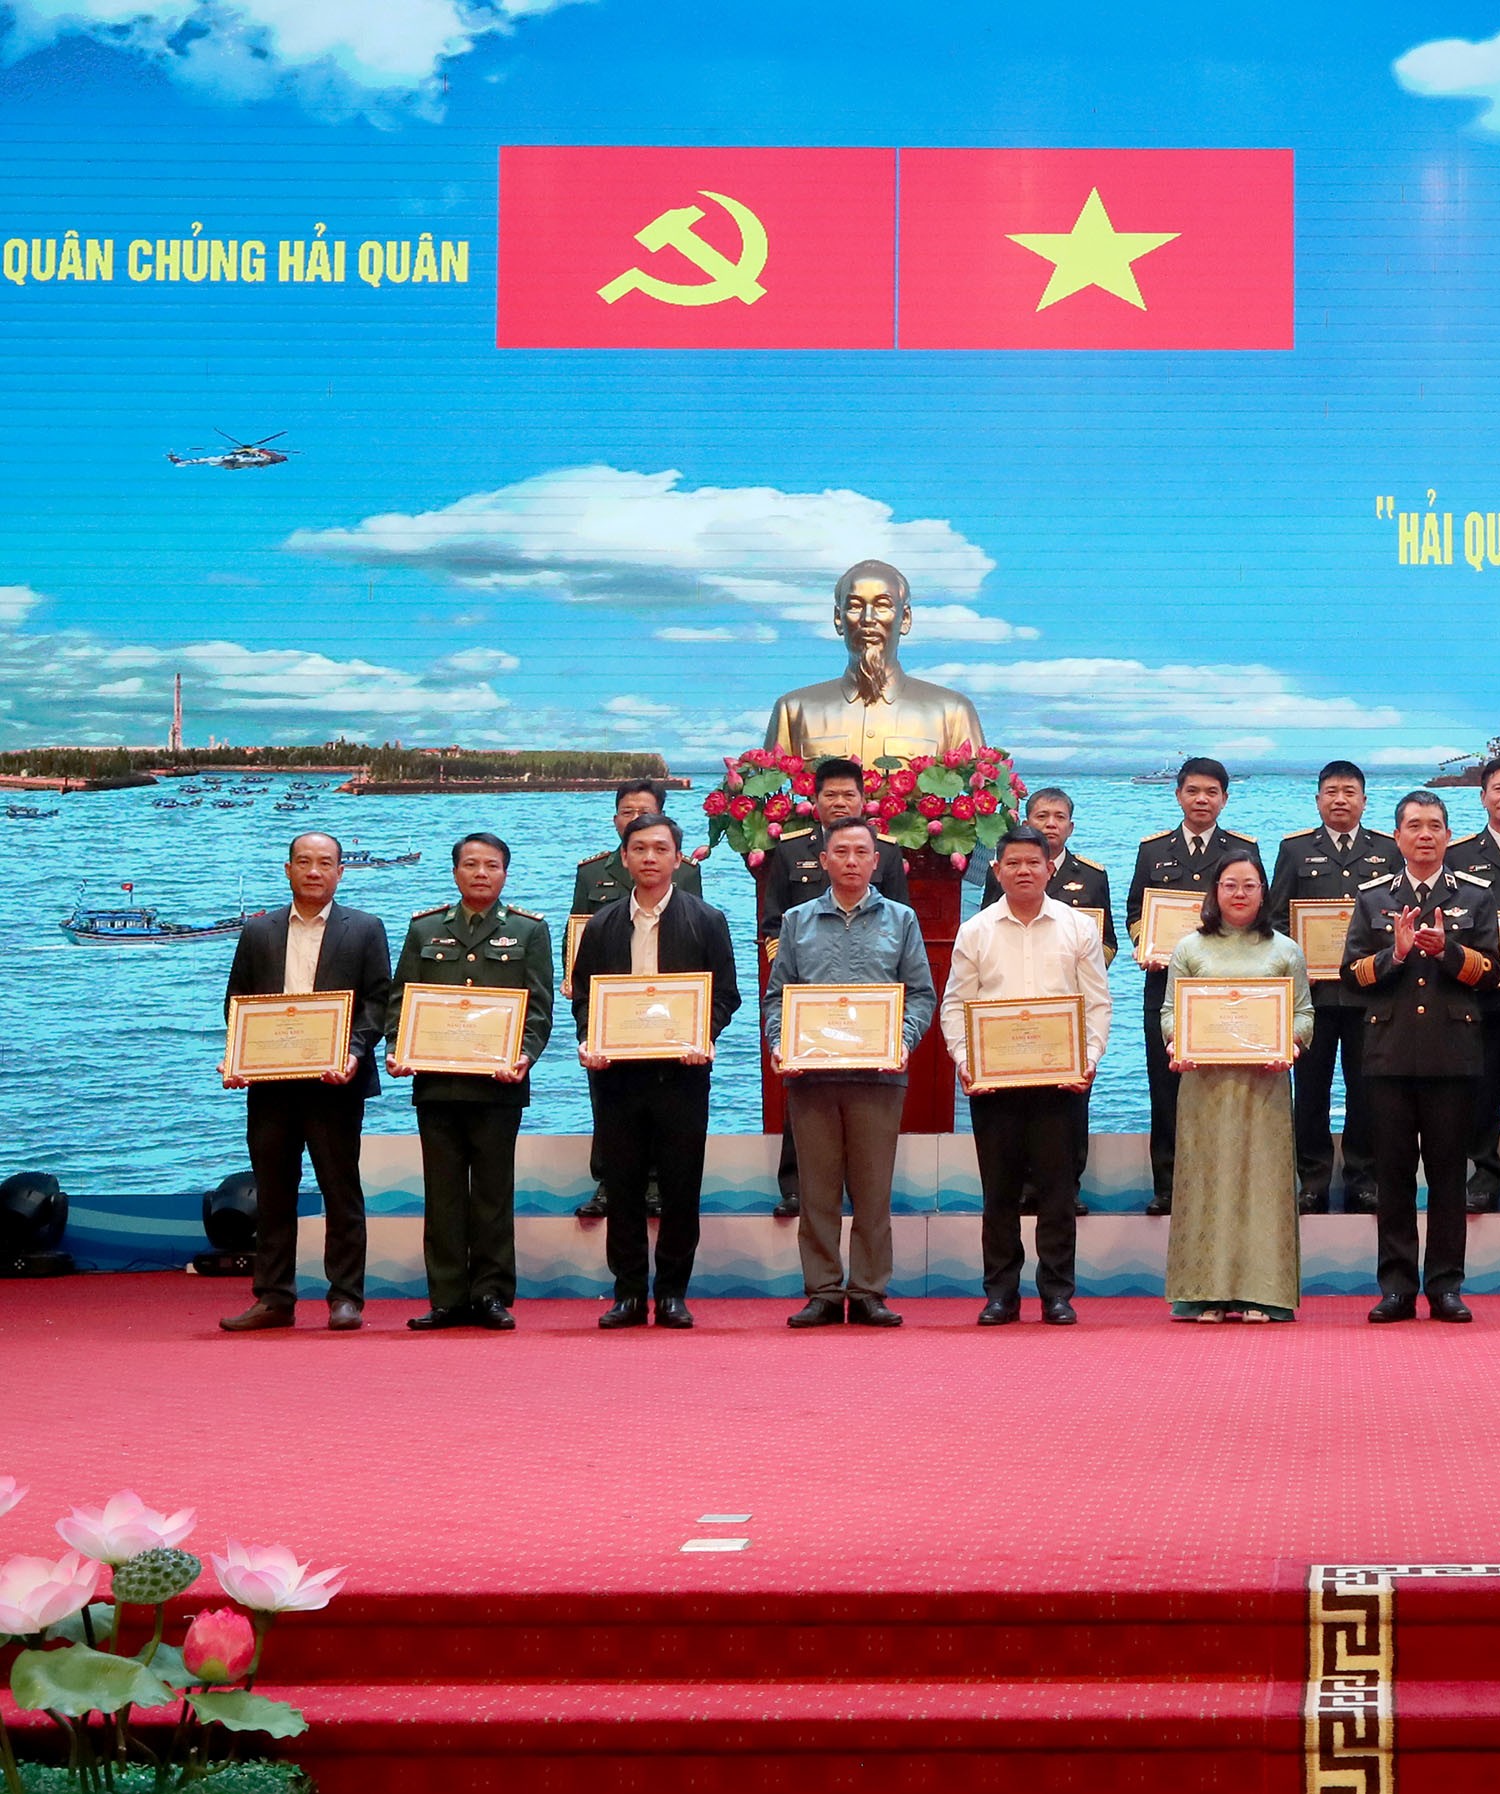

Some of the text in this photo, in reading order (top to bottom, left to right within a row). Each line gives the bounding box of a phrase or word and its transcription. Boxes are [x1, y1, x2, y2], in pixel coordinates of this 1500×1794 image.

[4, 222, 469, 288] QUÂN CHỦNG HẢI QUÂN
